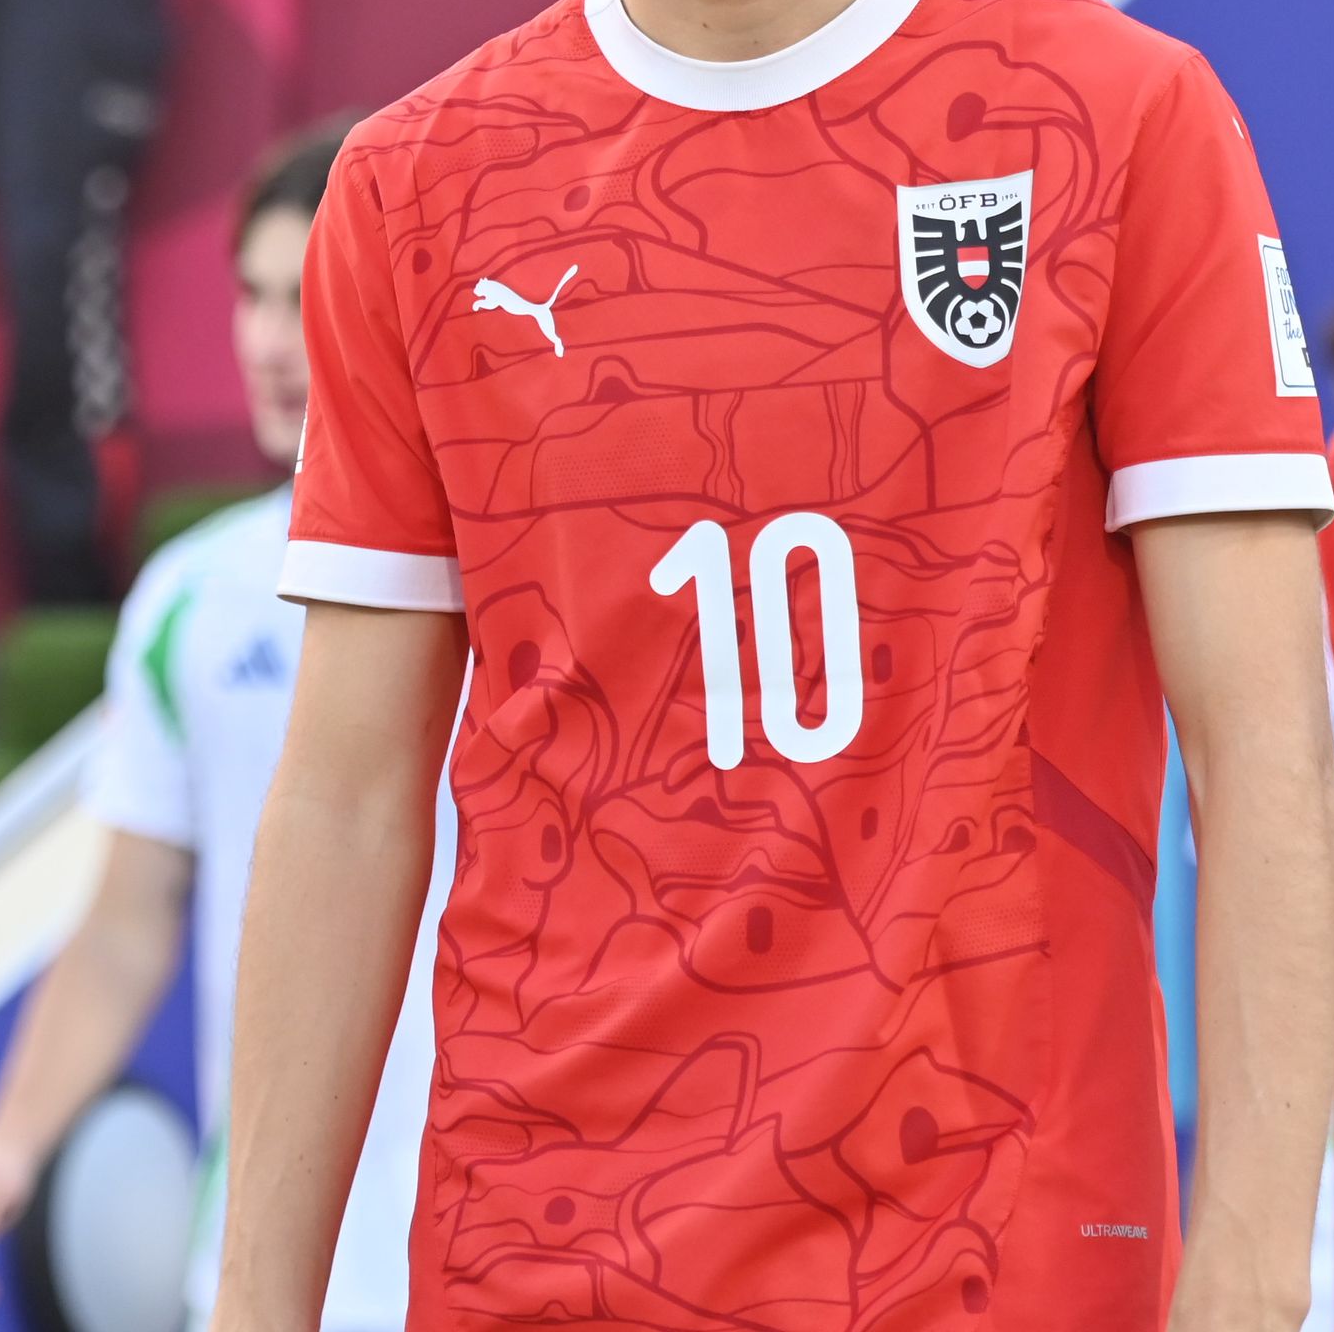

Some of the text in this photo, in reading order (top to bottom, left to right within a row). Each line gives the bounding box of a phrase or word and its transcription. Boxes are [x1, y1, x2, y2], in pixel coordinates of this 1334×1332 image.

[915, 193, 1019, 211] SEIT ÖFB 1904
[1283, 318, 1302, 340] the
[648, 511, 864, 771] 10
[1080, 1223, 1149, 1240] ULTRAWEAVE
